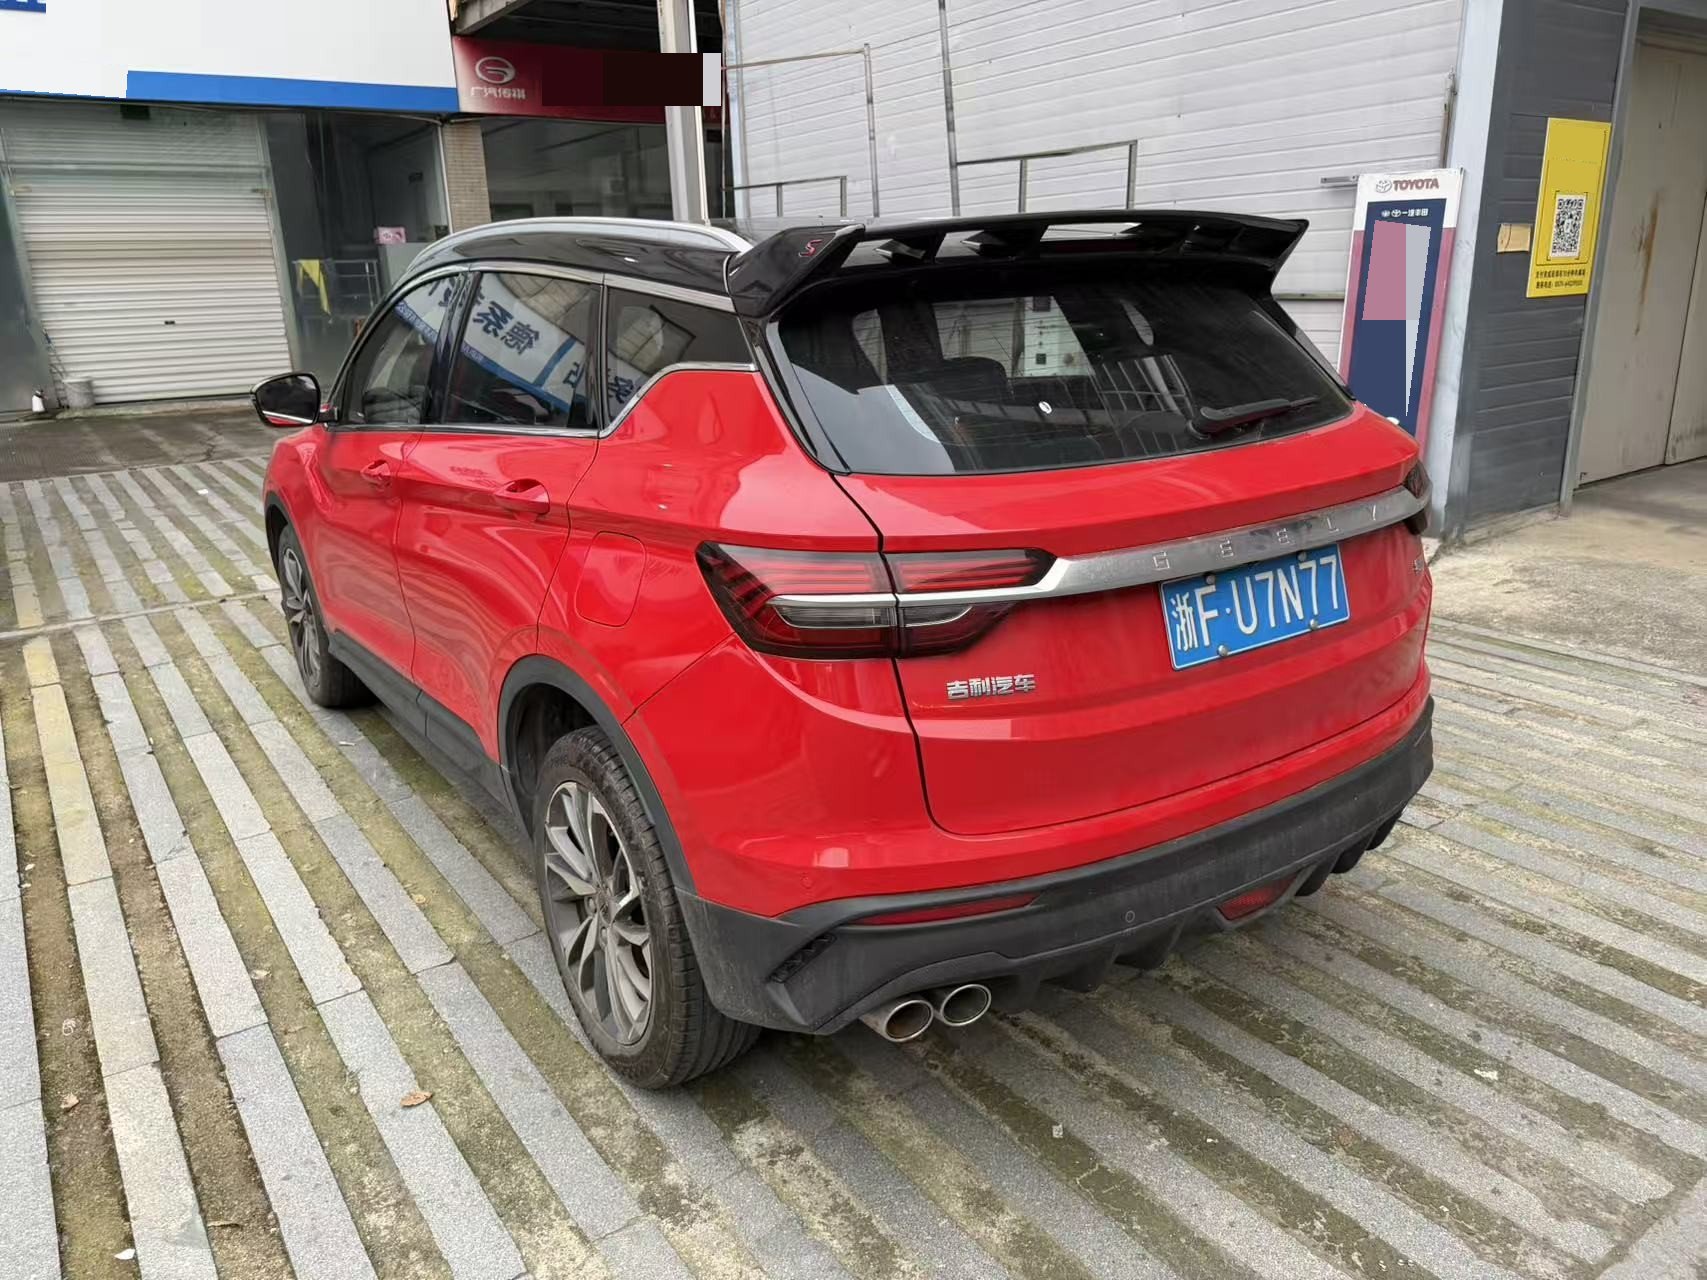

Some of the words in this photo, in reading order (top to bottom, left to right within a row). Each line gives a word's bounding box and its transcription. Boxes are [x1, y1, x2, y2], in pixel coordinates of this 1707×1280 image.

[1393, 178, 1440, 191] TOYOTA
[1152, 503, 1378, 571] GEELY
[946, 674, 1036, 699] 吉利汽车
